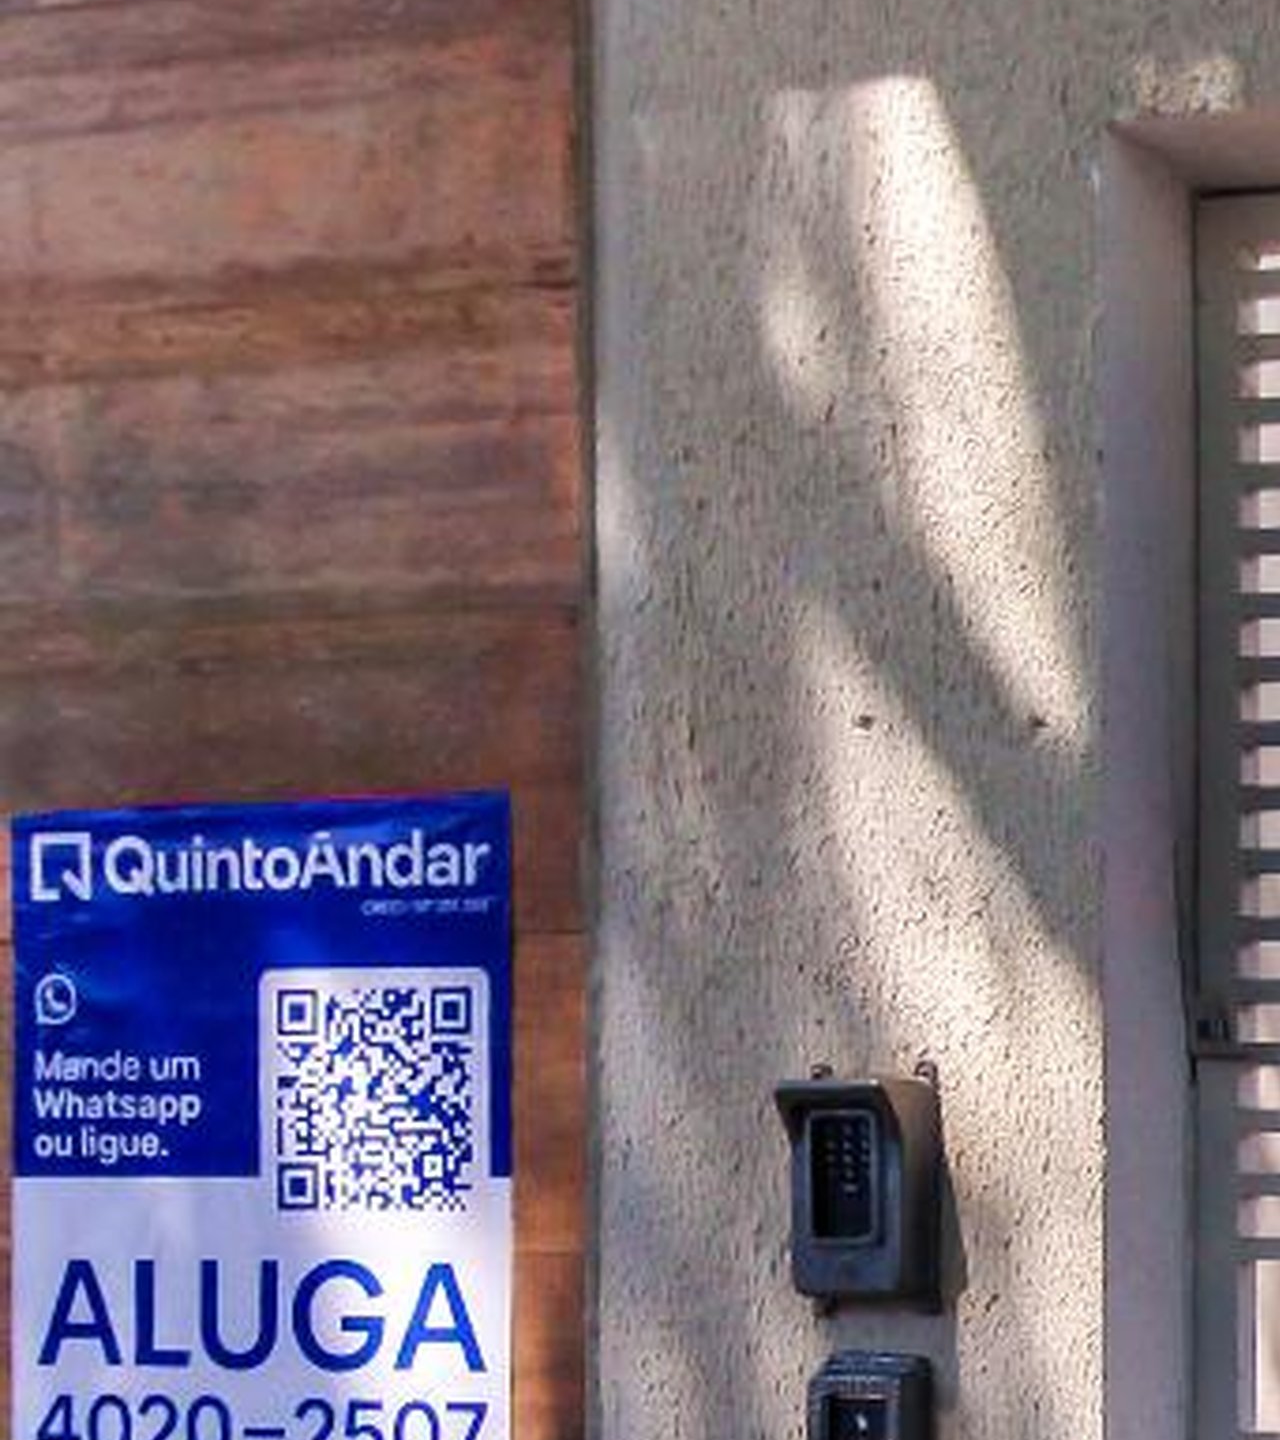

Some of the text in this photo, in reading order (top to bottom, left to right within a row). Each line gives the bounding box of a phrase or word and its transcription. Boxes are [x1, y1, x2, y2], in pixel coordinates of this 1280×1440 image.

[104, 828, 490, 896] QuintoAndar
[34, 1049, 201, 1081] Mande um
[33, 1087, 202, 1126] Whatsapp
[34, 1125, 169, 1165] ou ligue.
[37, 1258, 488, 1373] ALUGA
